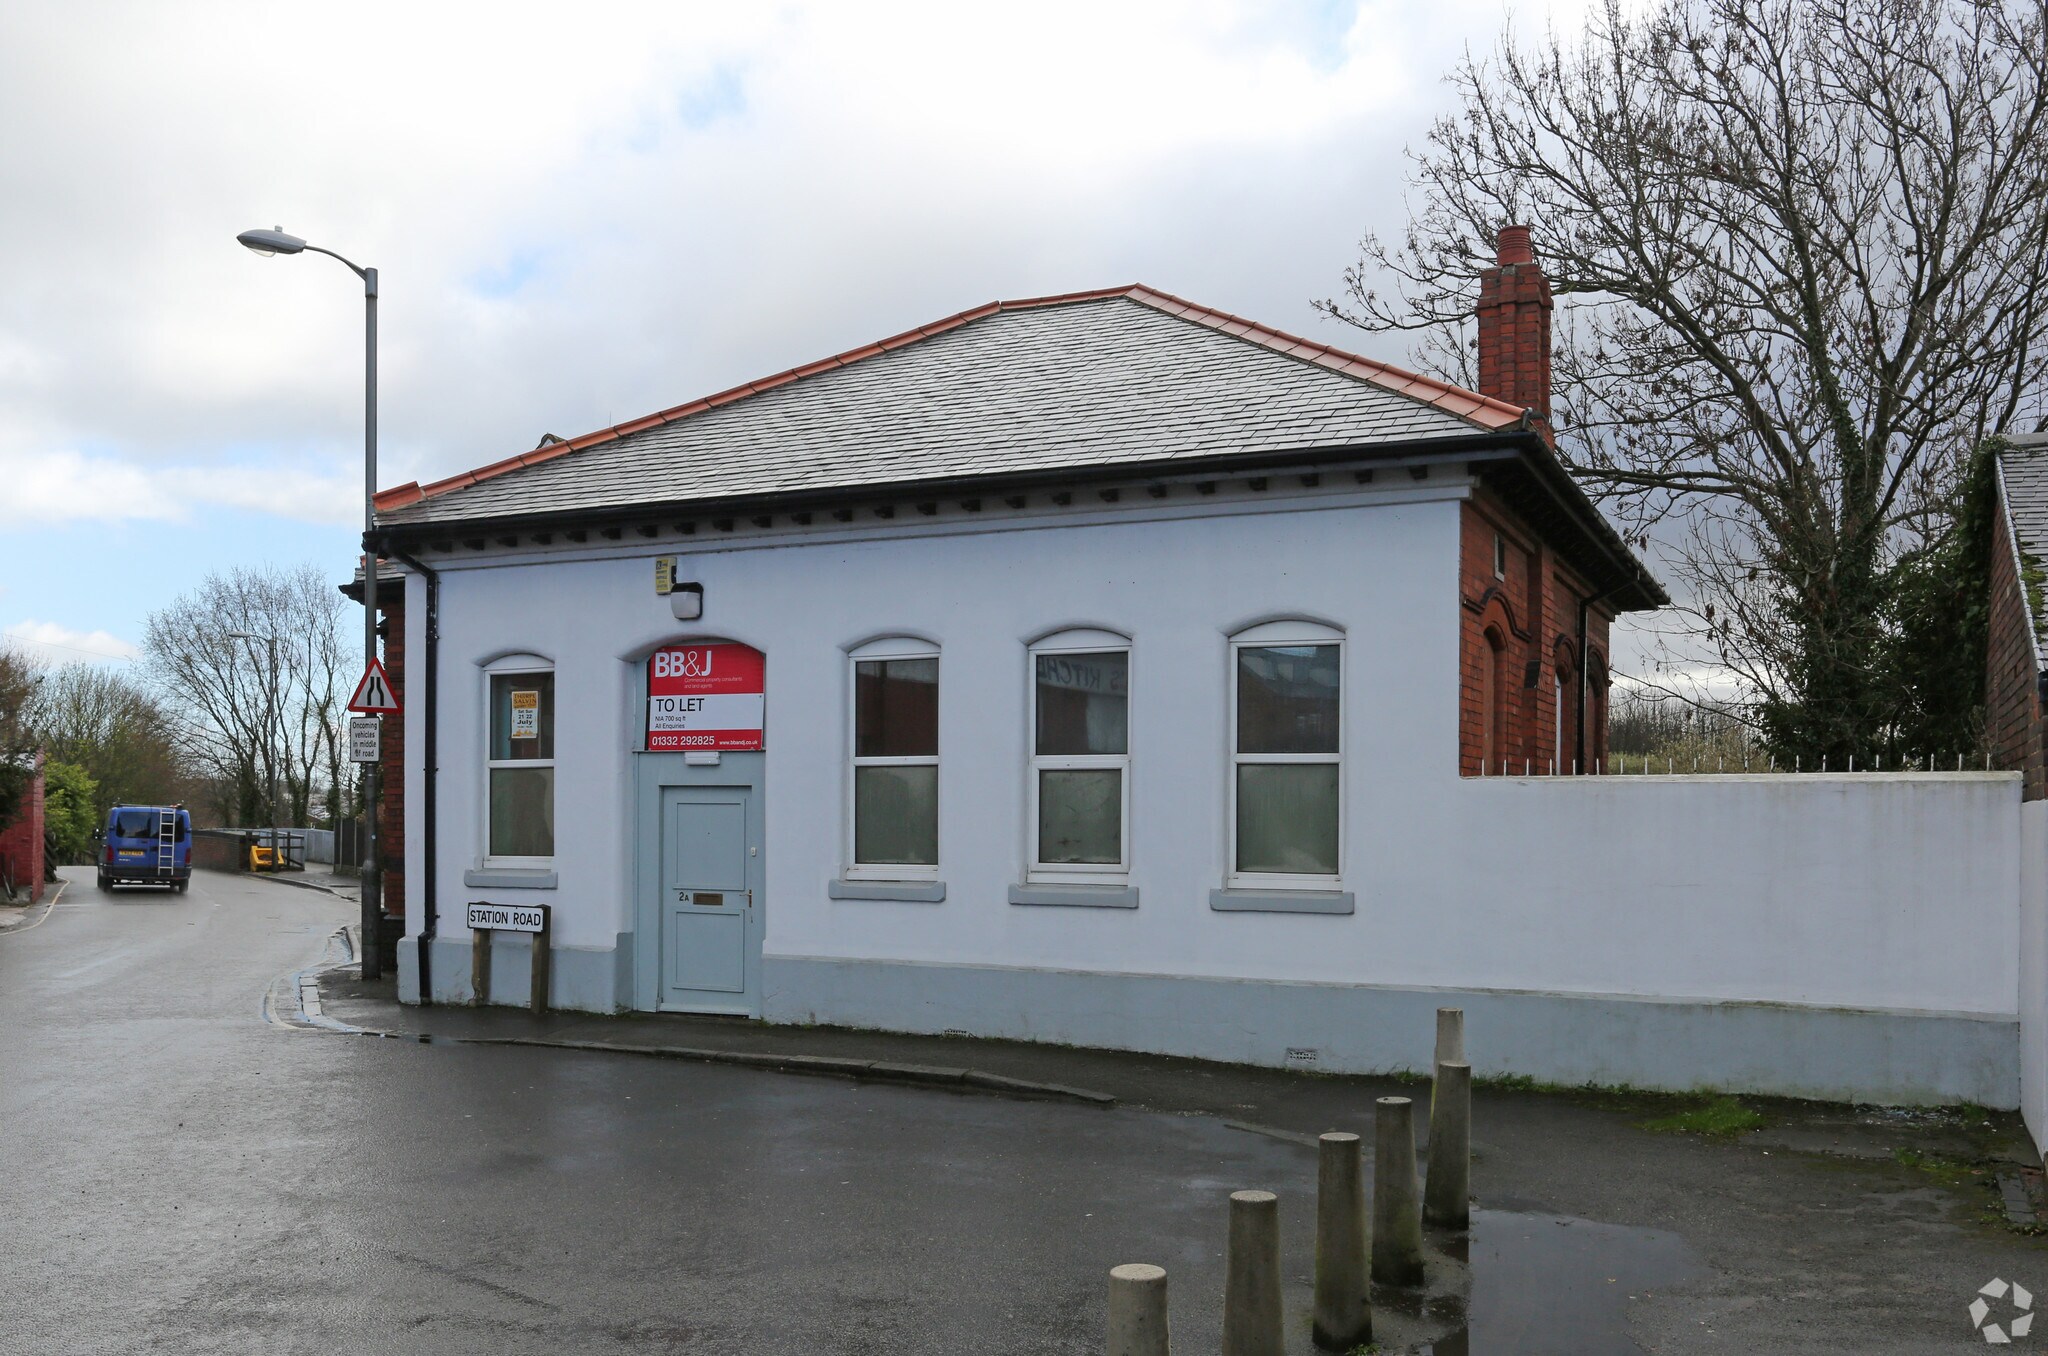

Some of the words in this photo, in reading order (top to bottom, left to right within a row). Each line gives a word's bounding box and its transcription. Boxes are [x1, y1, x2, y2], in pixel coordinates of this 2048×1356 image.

[654, 650, 712, 678] BB&J
[656, 698, 675, 712] TO
[679, 698, 705, 712] LET
[352, 721, 378, 730] Oncoming
[359, 740, 377, 748] middle
[652, 736, 678, 746] 01332
[680, 735, 715, 746] 292825
[362, 749, 375, 757] road
[470, 909, 509, 925] STATION
[513, 912, 541, 926] ROAD
